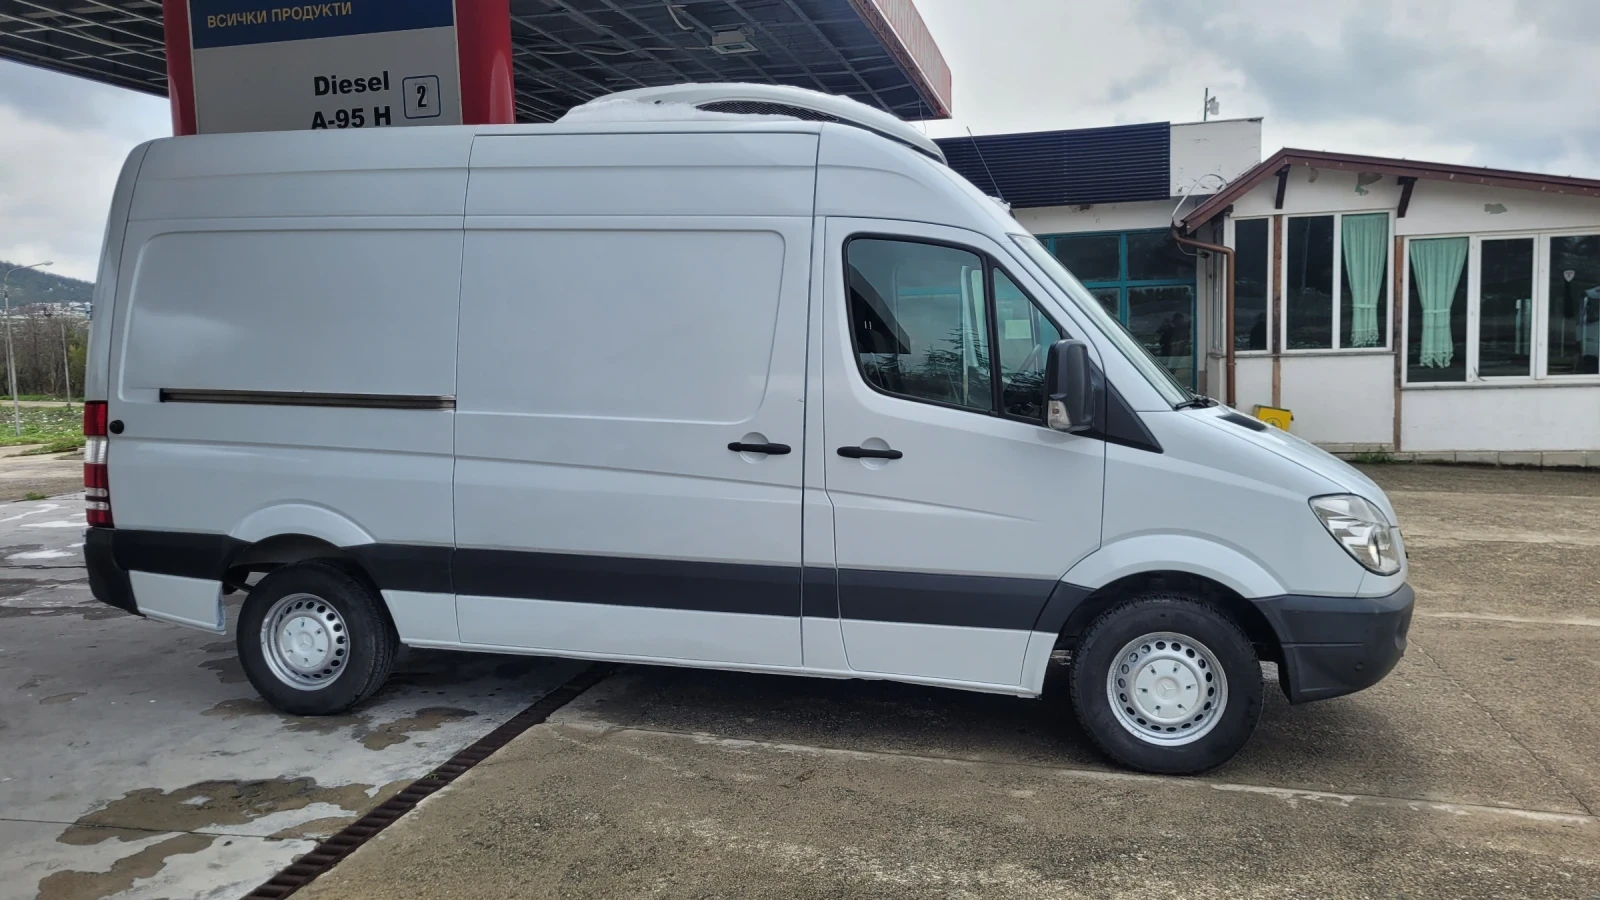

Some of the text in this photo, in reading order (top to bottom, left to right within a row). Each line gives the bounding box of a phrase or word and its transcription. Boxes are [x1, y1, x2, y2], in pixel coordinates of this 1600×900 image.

[207, 1, 352, 28] ВСИЧКИ ПРОДУКТИ
[313, 70, 390, 96] Diesel
[416, 85, 428, 108] 2
[311, 107, 365, 129] A-95
